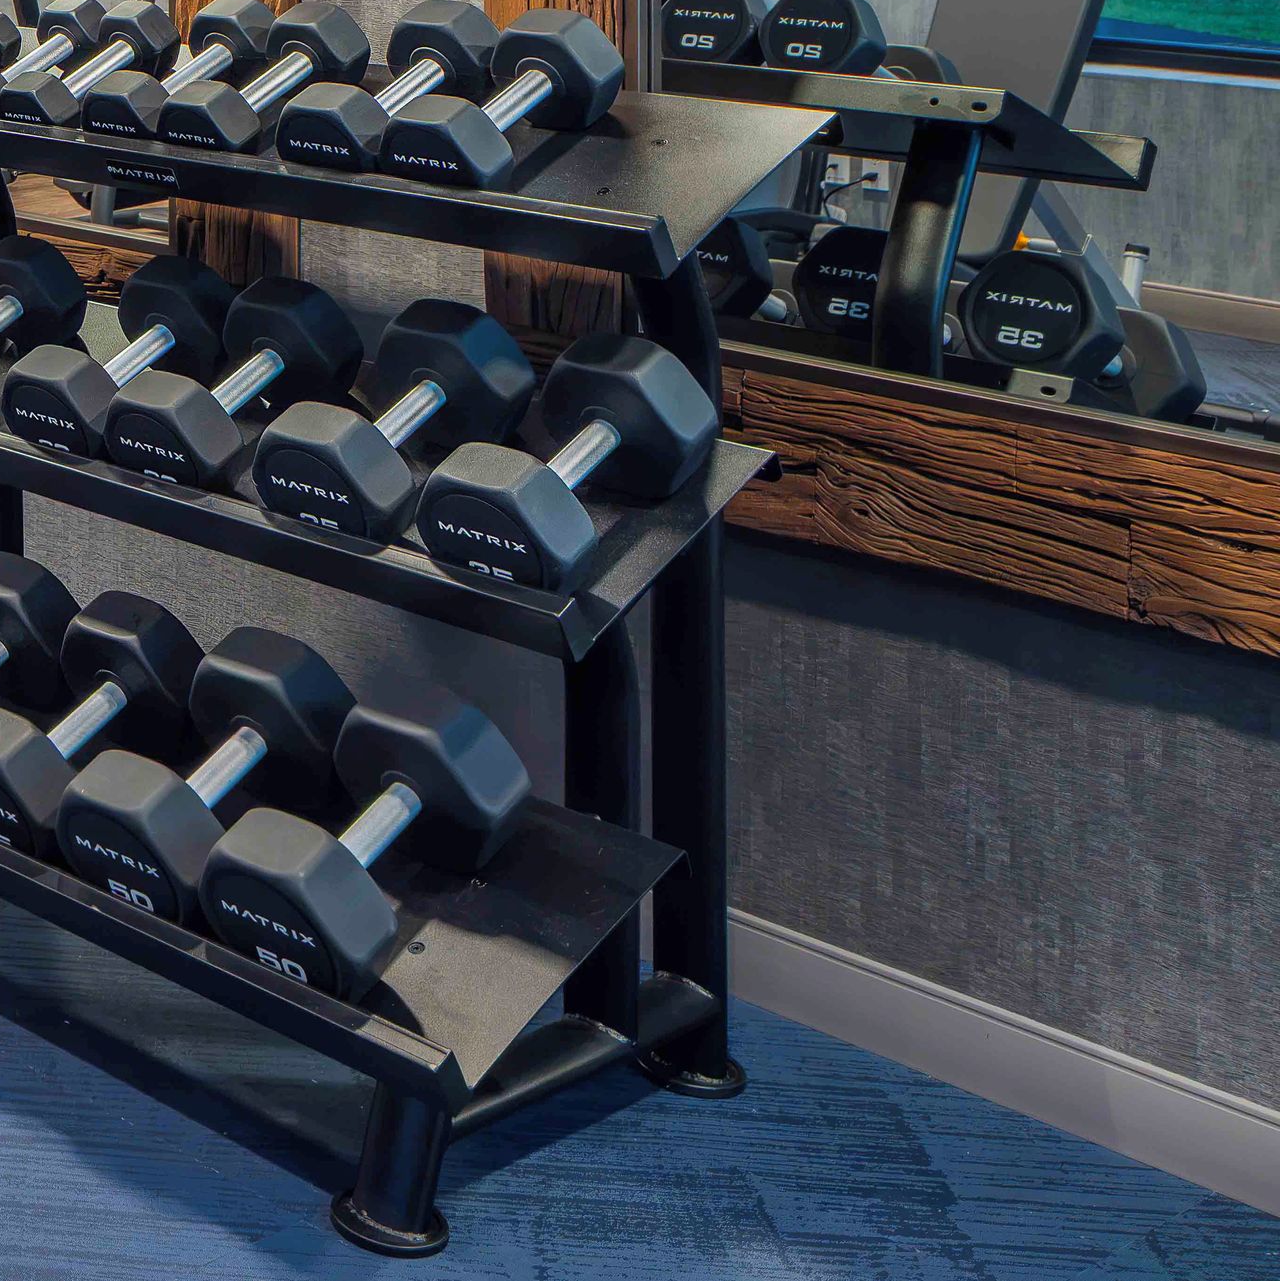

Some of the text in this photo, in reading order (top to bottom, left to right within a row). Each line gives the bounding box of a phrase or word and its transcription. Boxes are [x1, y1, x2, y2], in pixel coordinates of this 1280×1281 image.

[4, 112, 41, 122] MATRIX
[92, 121, 136, 133] MATRIX
[168, 131, 216, 144] MATRIX
[290, 139, 350, 156] MATRIX
[394, 154, 458, 170] MATRIX
[114, 167, 170, 182] MATRIX
[16, 408, 76, 430] MATRIX
[120, 436, 186, 462] MATRIX
[270, 475, 350, 504] MATRIX
[438, 520, 528, 554] MATRIX
[76, 835, 160, 878] MATRIX
[107, 878, 154, 912] 50
[220, 900, 316, 948] MATRIX
[256, 946, 308, 984] 50
